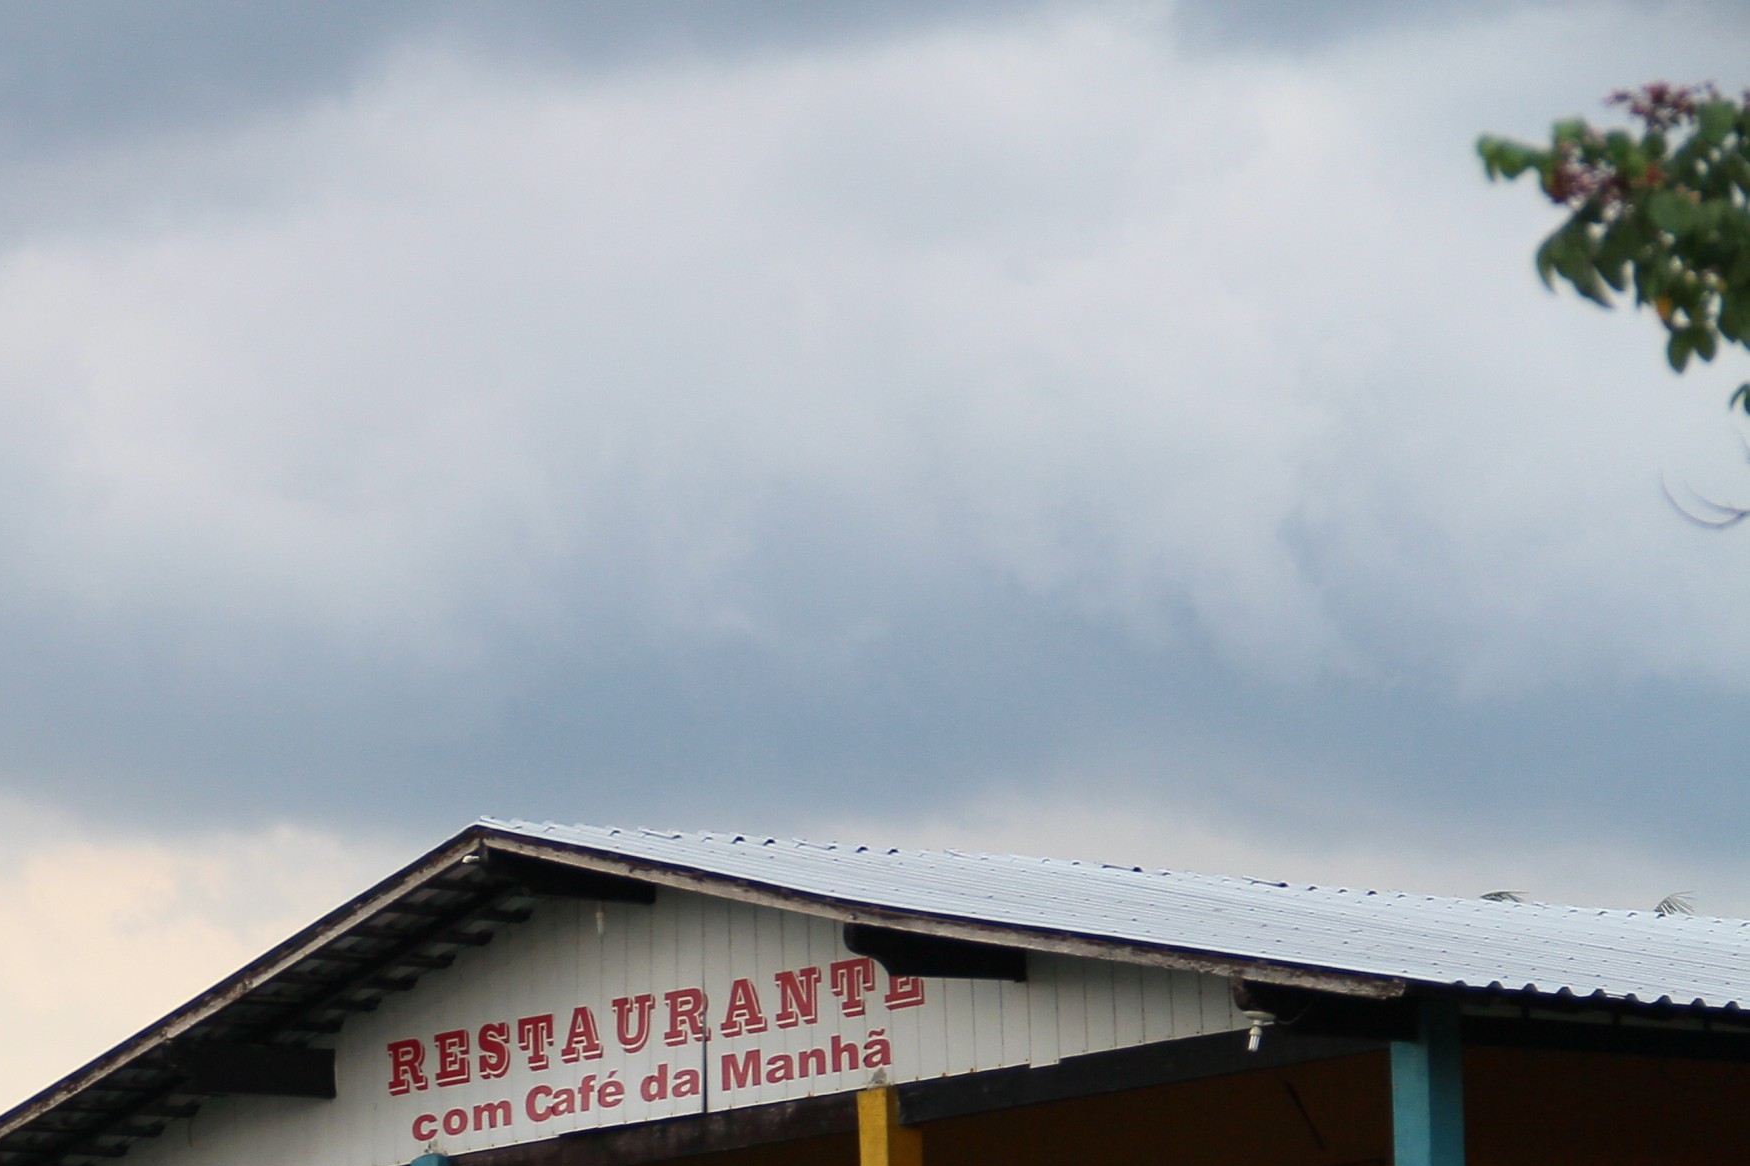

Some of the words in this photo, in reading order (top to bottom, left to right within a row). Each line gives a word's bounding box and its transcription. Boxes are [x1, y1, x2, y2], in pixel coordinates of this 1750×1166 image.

[386, 956, 927, 1097] RESTAURANTE
[411, 1097, 514, 1143] com
[524, 1068, 626, 1124] Café
[639, 1061, 703, 1103] da
[721, 1027, 893, 1093] Manhã
